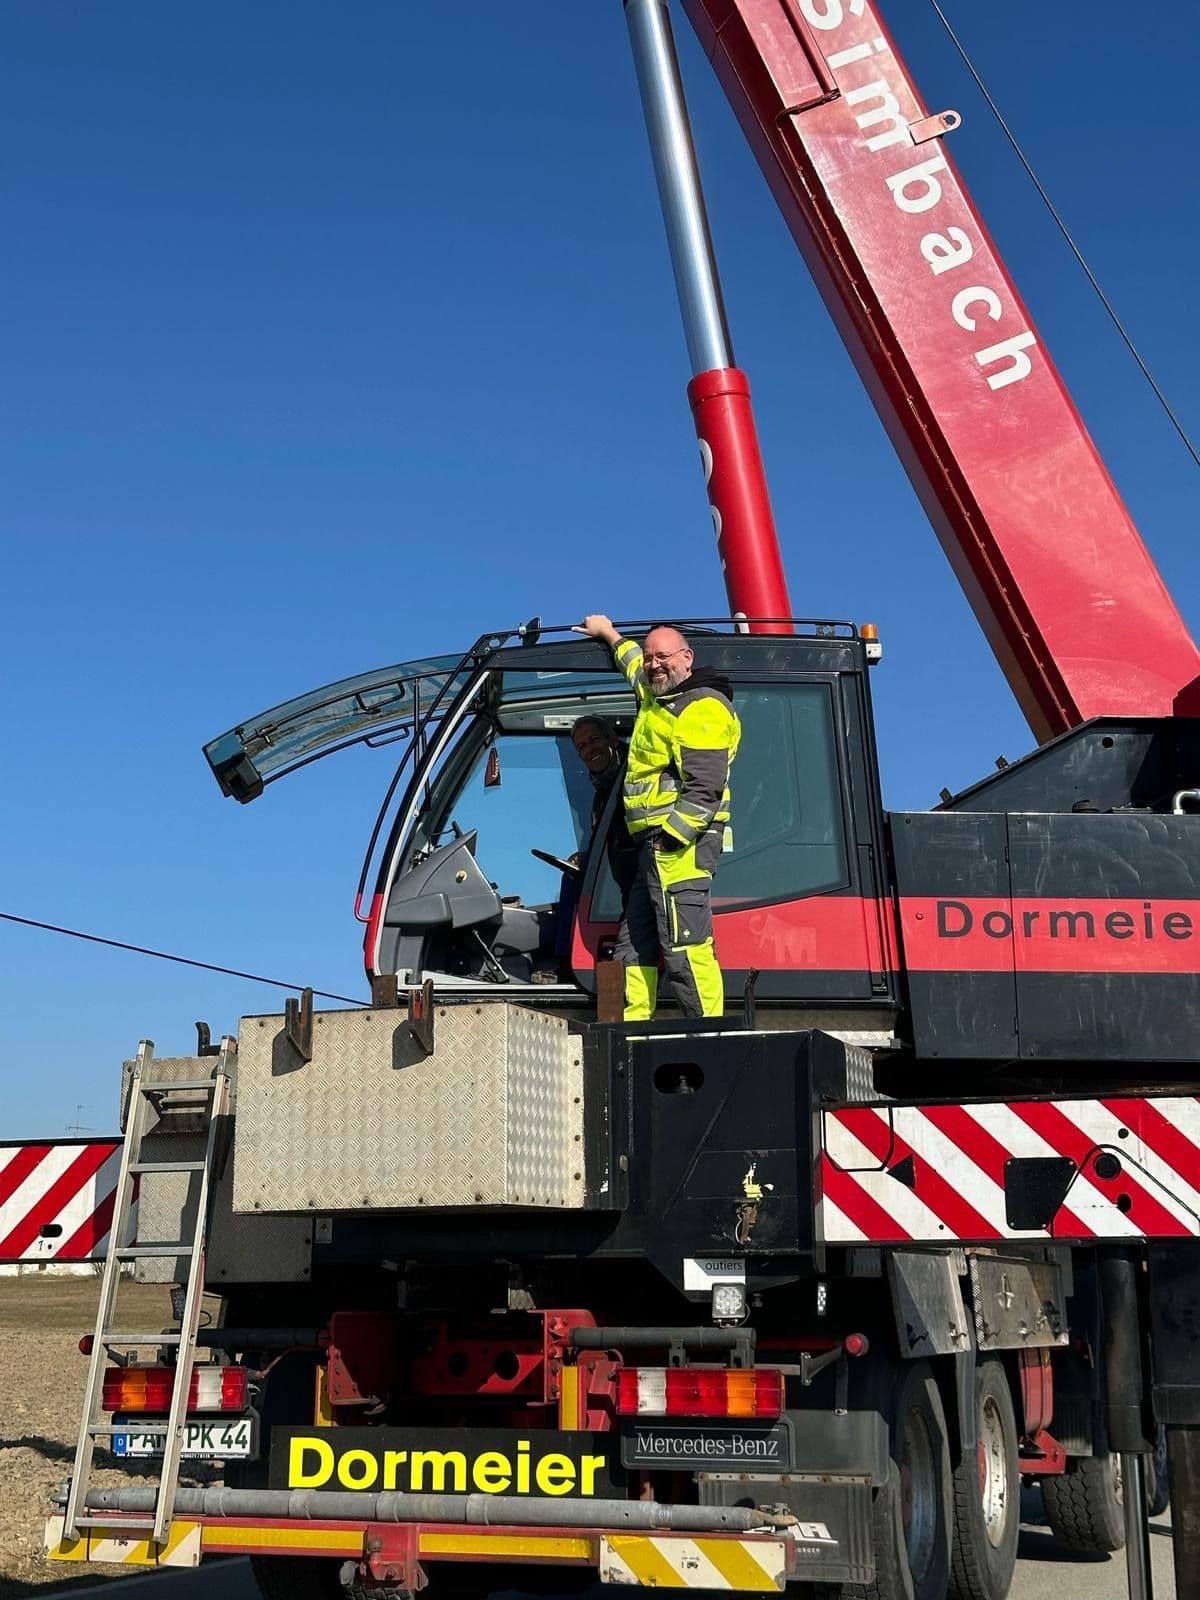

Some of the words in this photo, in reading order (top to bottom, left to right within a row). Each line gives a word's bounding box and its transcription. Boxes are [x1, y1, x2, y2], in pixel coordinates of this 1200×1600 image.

[936, 900, 1194, 940] Dormeie
[187, 1423, 216, 1449] PK
[220, 1423, 248, 1449] 44
[636, 1432, 779, 1456] Mercedes-Benz
[288, 1437, 606, 1496] Dormeier
